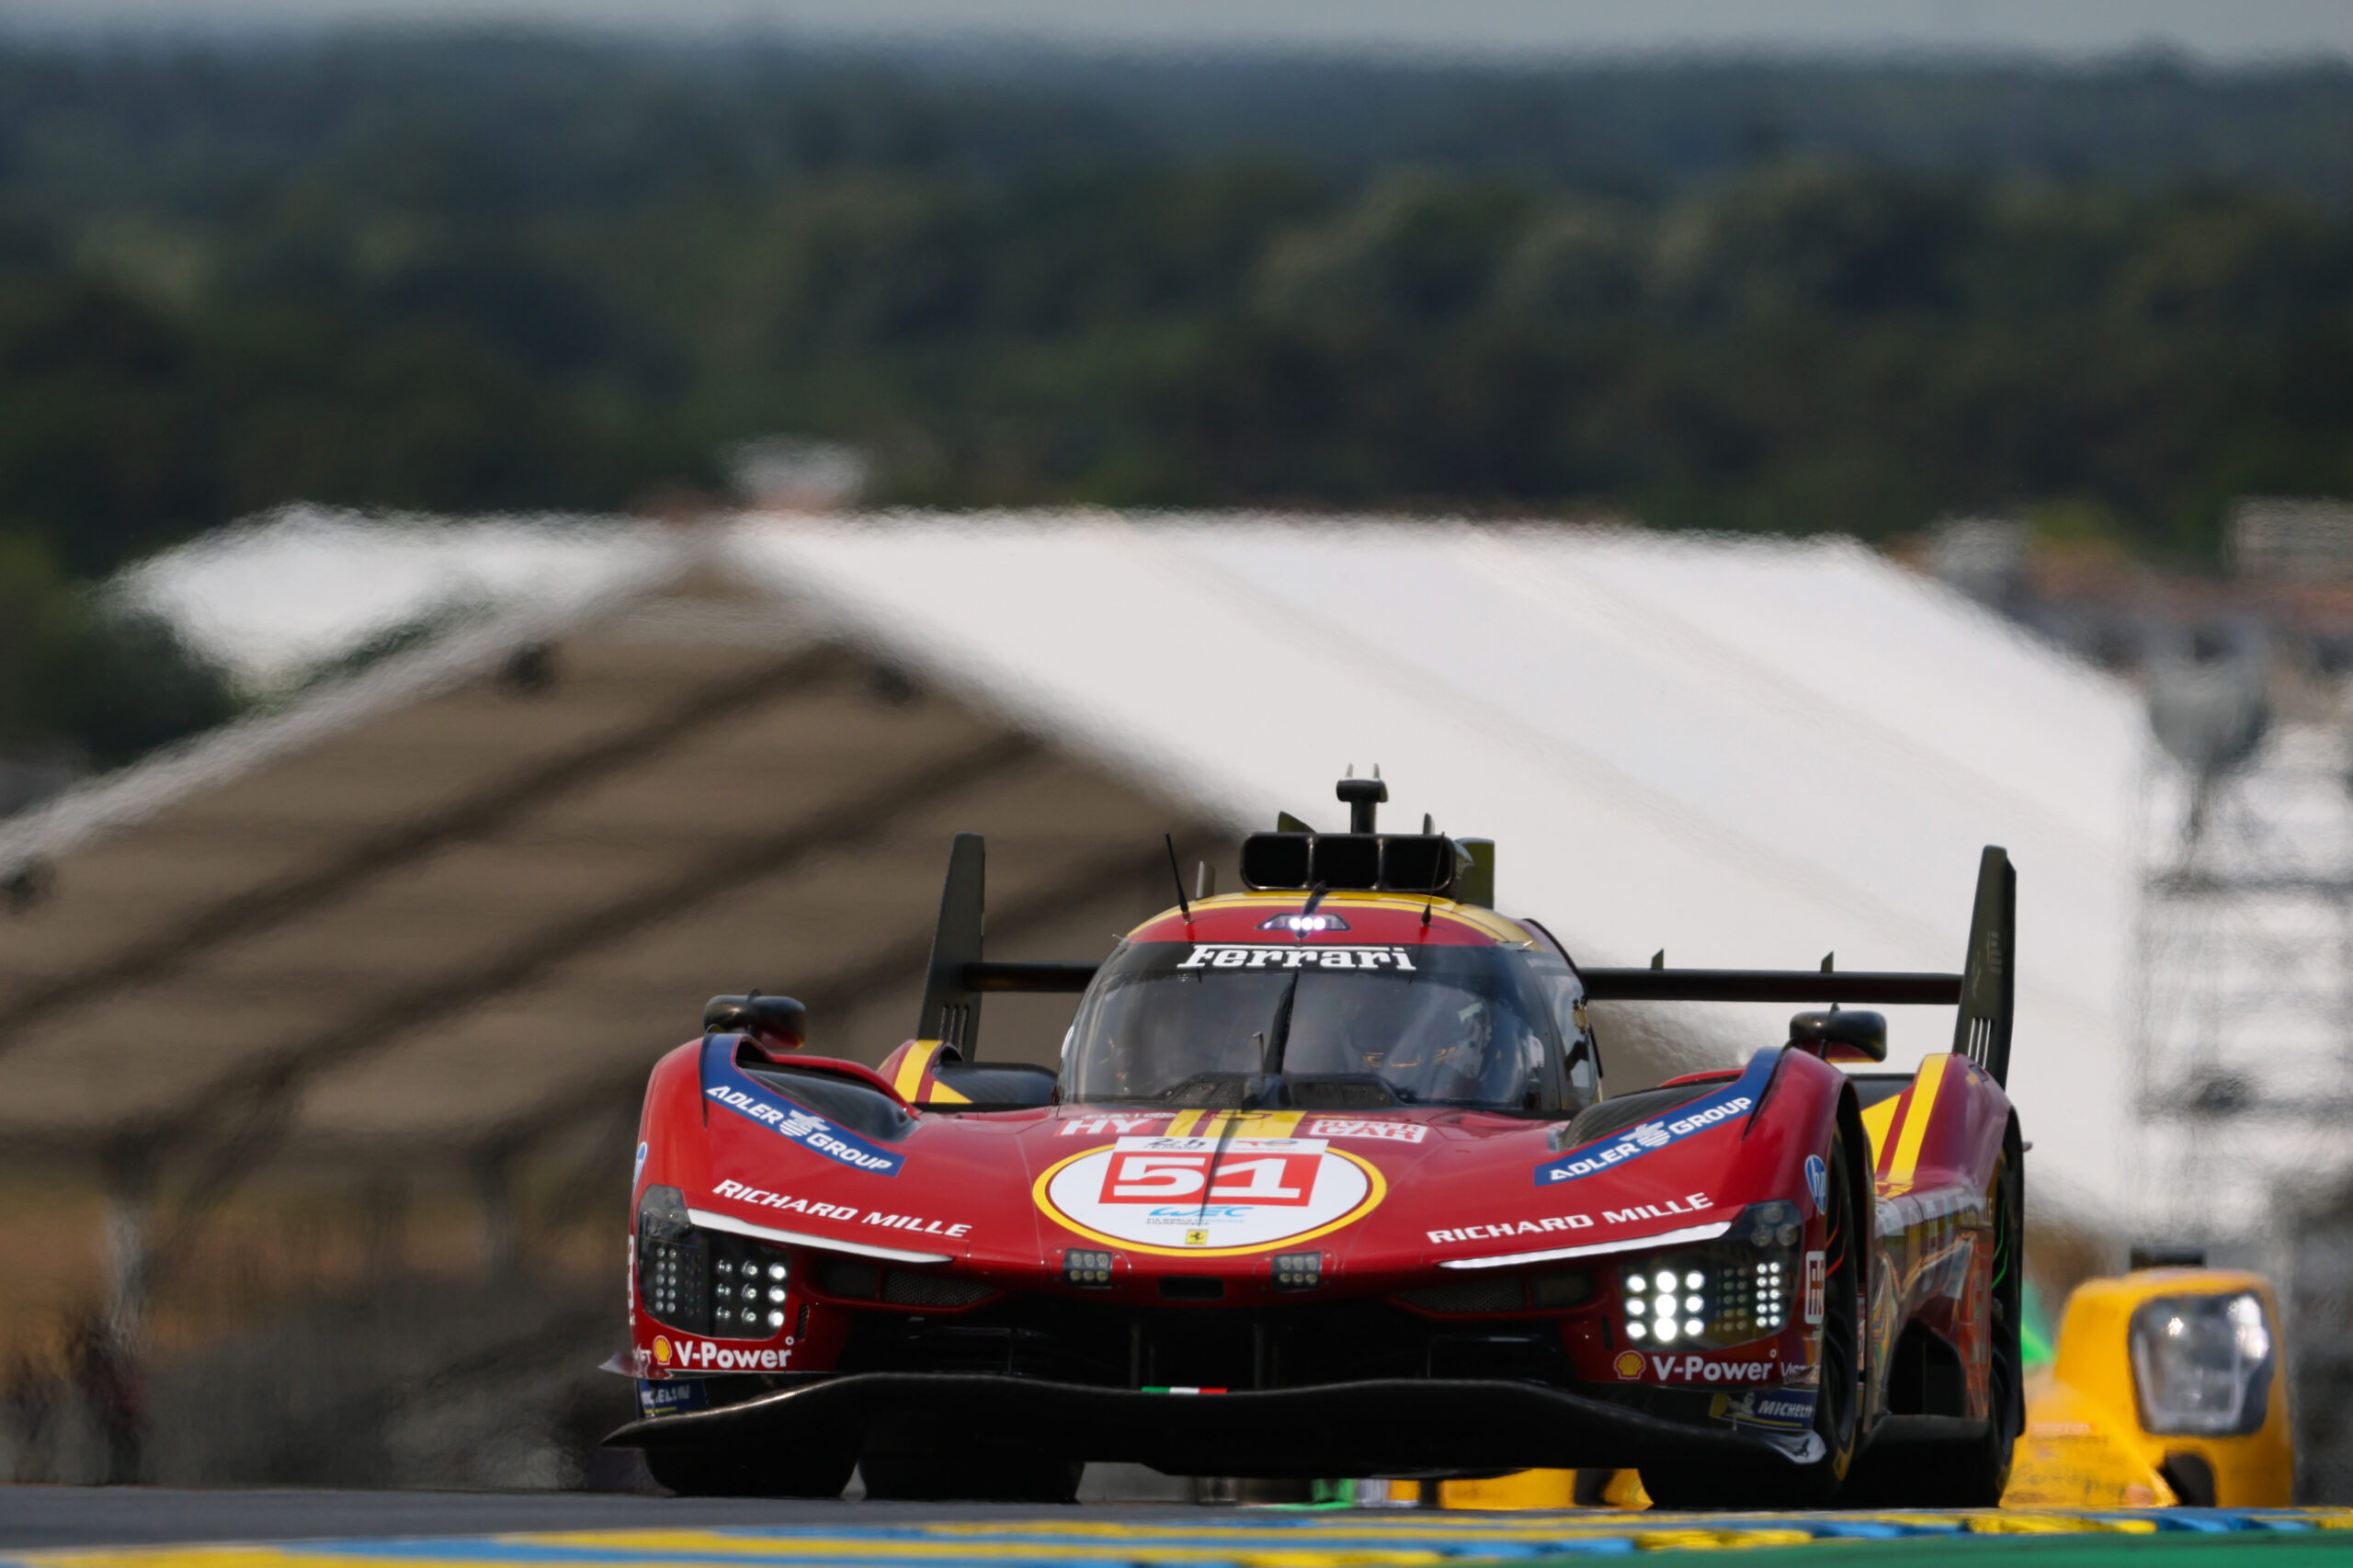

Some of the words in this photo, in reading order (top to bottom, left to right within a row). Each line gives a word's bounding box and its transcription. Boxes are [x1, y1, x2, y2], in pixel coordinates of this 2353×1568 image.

[1176, 944, 1416, 971] Ferrari
[707, 1085, 782, 1125] ADLER
[807, 1131, 892, 1170] GROUP
[1061, 1119, 1151, 1135] HY
[1318, 1126, 1415, 1141] CAR
[1550, 1142, 1641, 1181] ADLER
[1670, 1097, 1752, 1135] GROUP
[1113, 1156, 1302, 1199] 51
[712, 1179, 858, 1221] RICHARD
[861, 1210, 972, 1237] MILLE
[1148, 1205, 1255, 1217] WEC
[1426, 1212, 1594, 1244] RICHARD
[1603, 1192, 1714, 1224] MILLE
[675, 1341, 792, 1369] V-Power
[1652, 1356, 1773, 1381] V-Power
